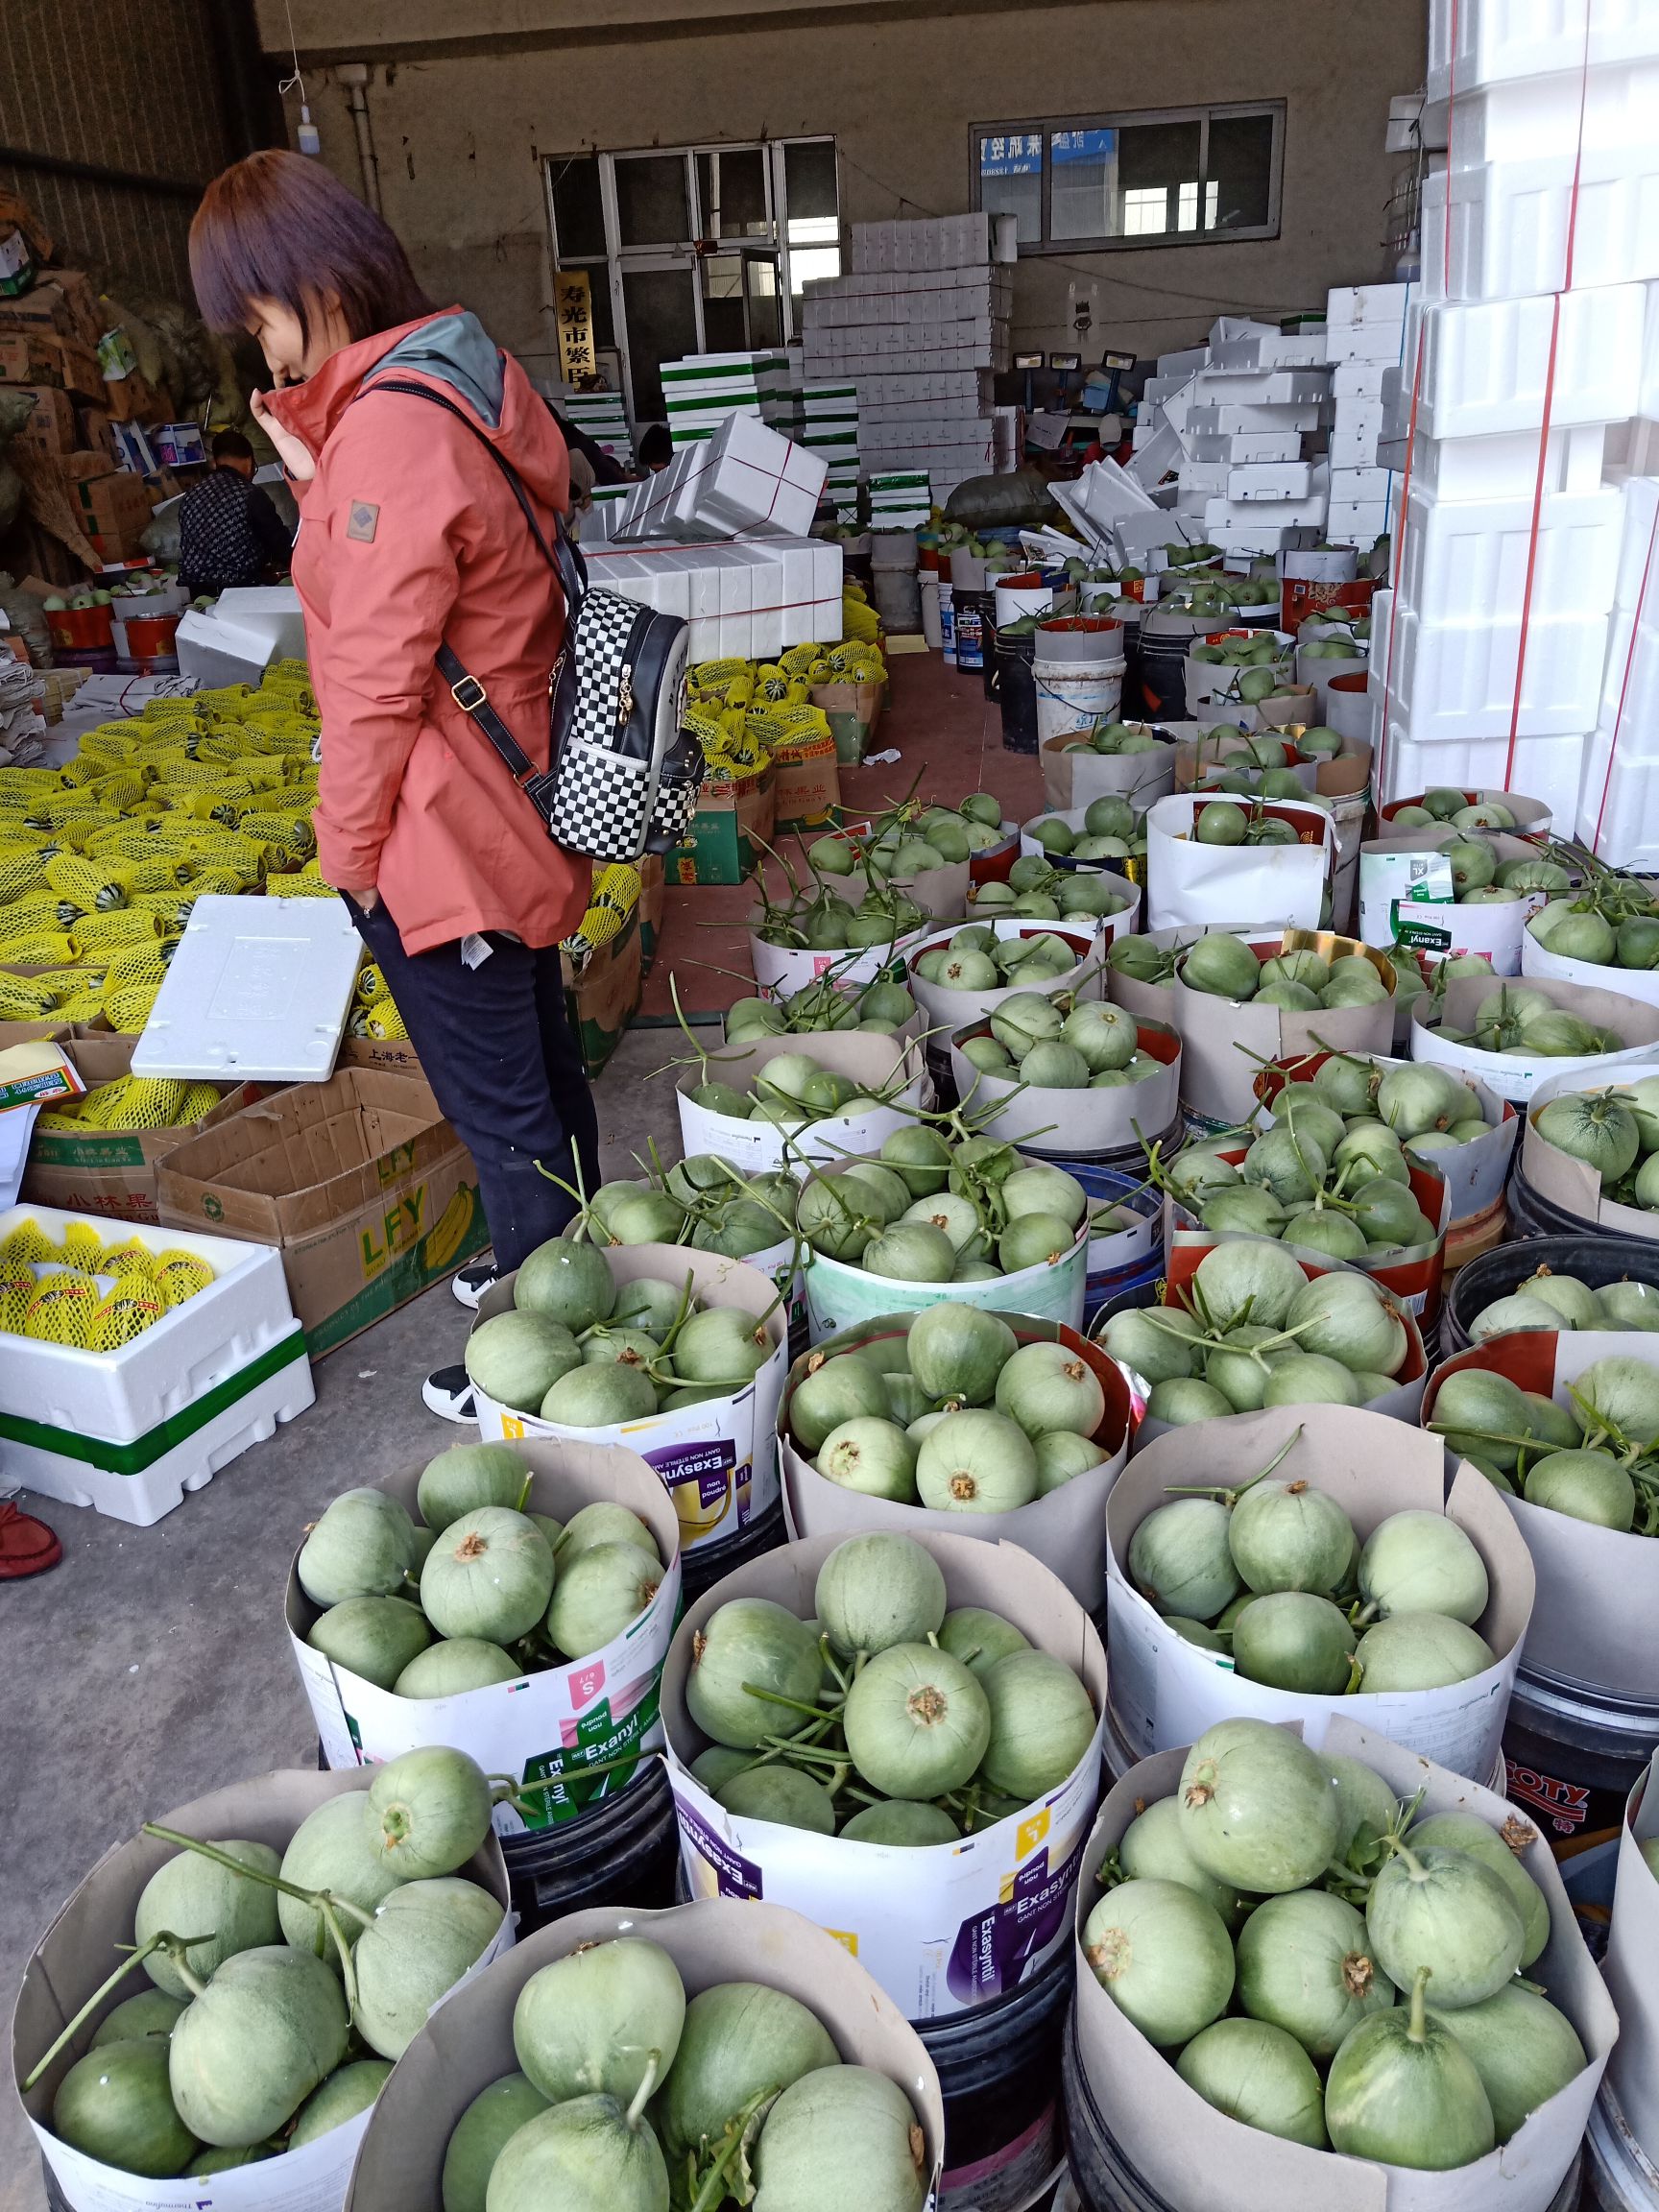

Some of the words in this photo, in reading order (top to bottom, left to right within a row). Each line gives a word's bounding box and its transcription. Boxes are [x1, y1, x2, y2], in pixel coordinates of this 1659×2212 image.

[1412, 867, 1425, 876] XL
[1410, 934, 1442, 947] Exanyl
[377, 1140, 416, 1180] LFY
[362, 1186, 423, 1265] LFY
[688, 1452, 703, 1461] NON
[703, 1447, 721, 1457] GANT
[701, 1484, 727, 1499] poudré
[707, 1479, 721, 1489] non
[582, 1681, 594, 1695] S
[581, 1710, 608, 1729] poudré
[588, 1719, 603, 1733] non
[585, 1713, 638, 1761] Exanyl
[589, 1755, 609, 1767] GANT
[608, 1745, 623, 1758] NON
[548, 1758, 567, 1804] Exnyl
[724, 1852, 742, 1868] GANT
[1018, 1861, 1045, 1882] poudré
[1023, 1873, 1039, 1885] non
[1017, 1908, 1037, 1924] GANT
[1037, 1897, 1052, 1912] NON
[981, 1915, 996, 1983] Exasyntil
